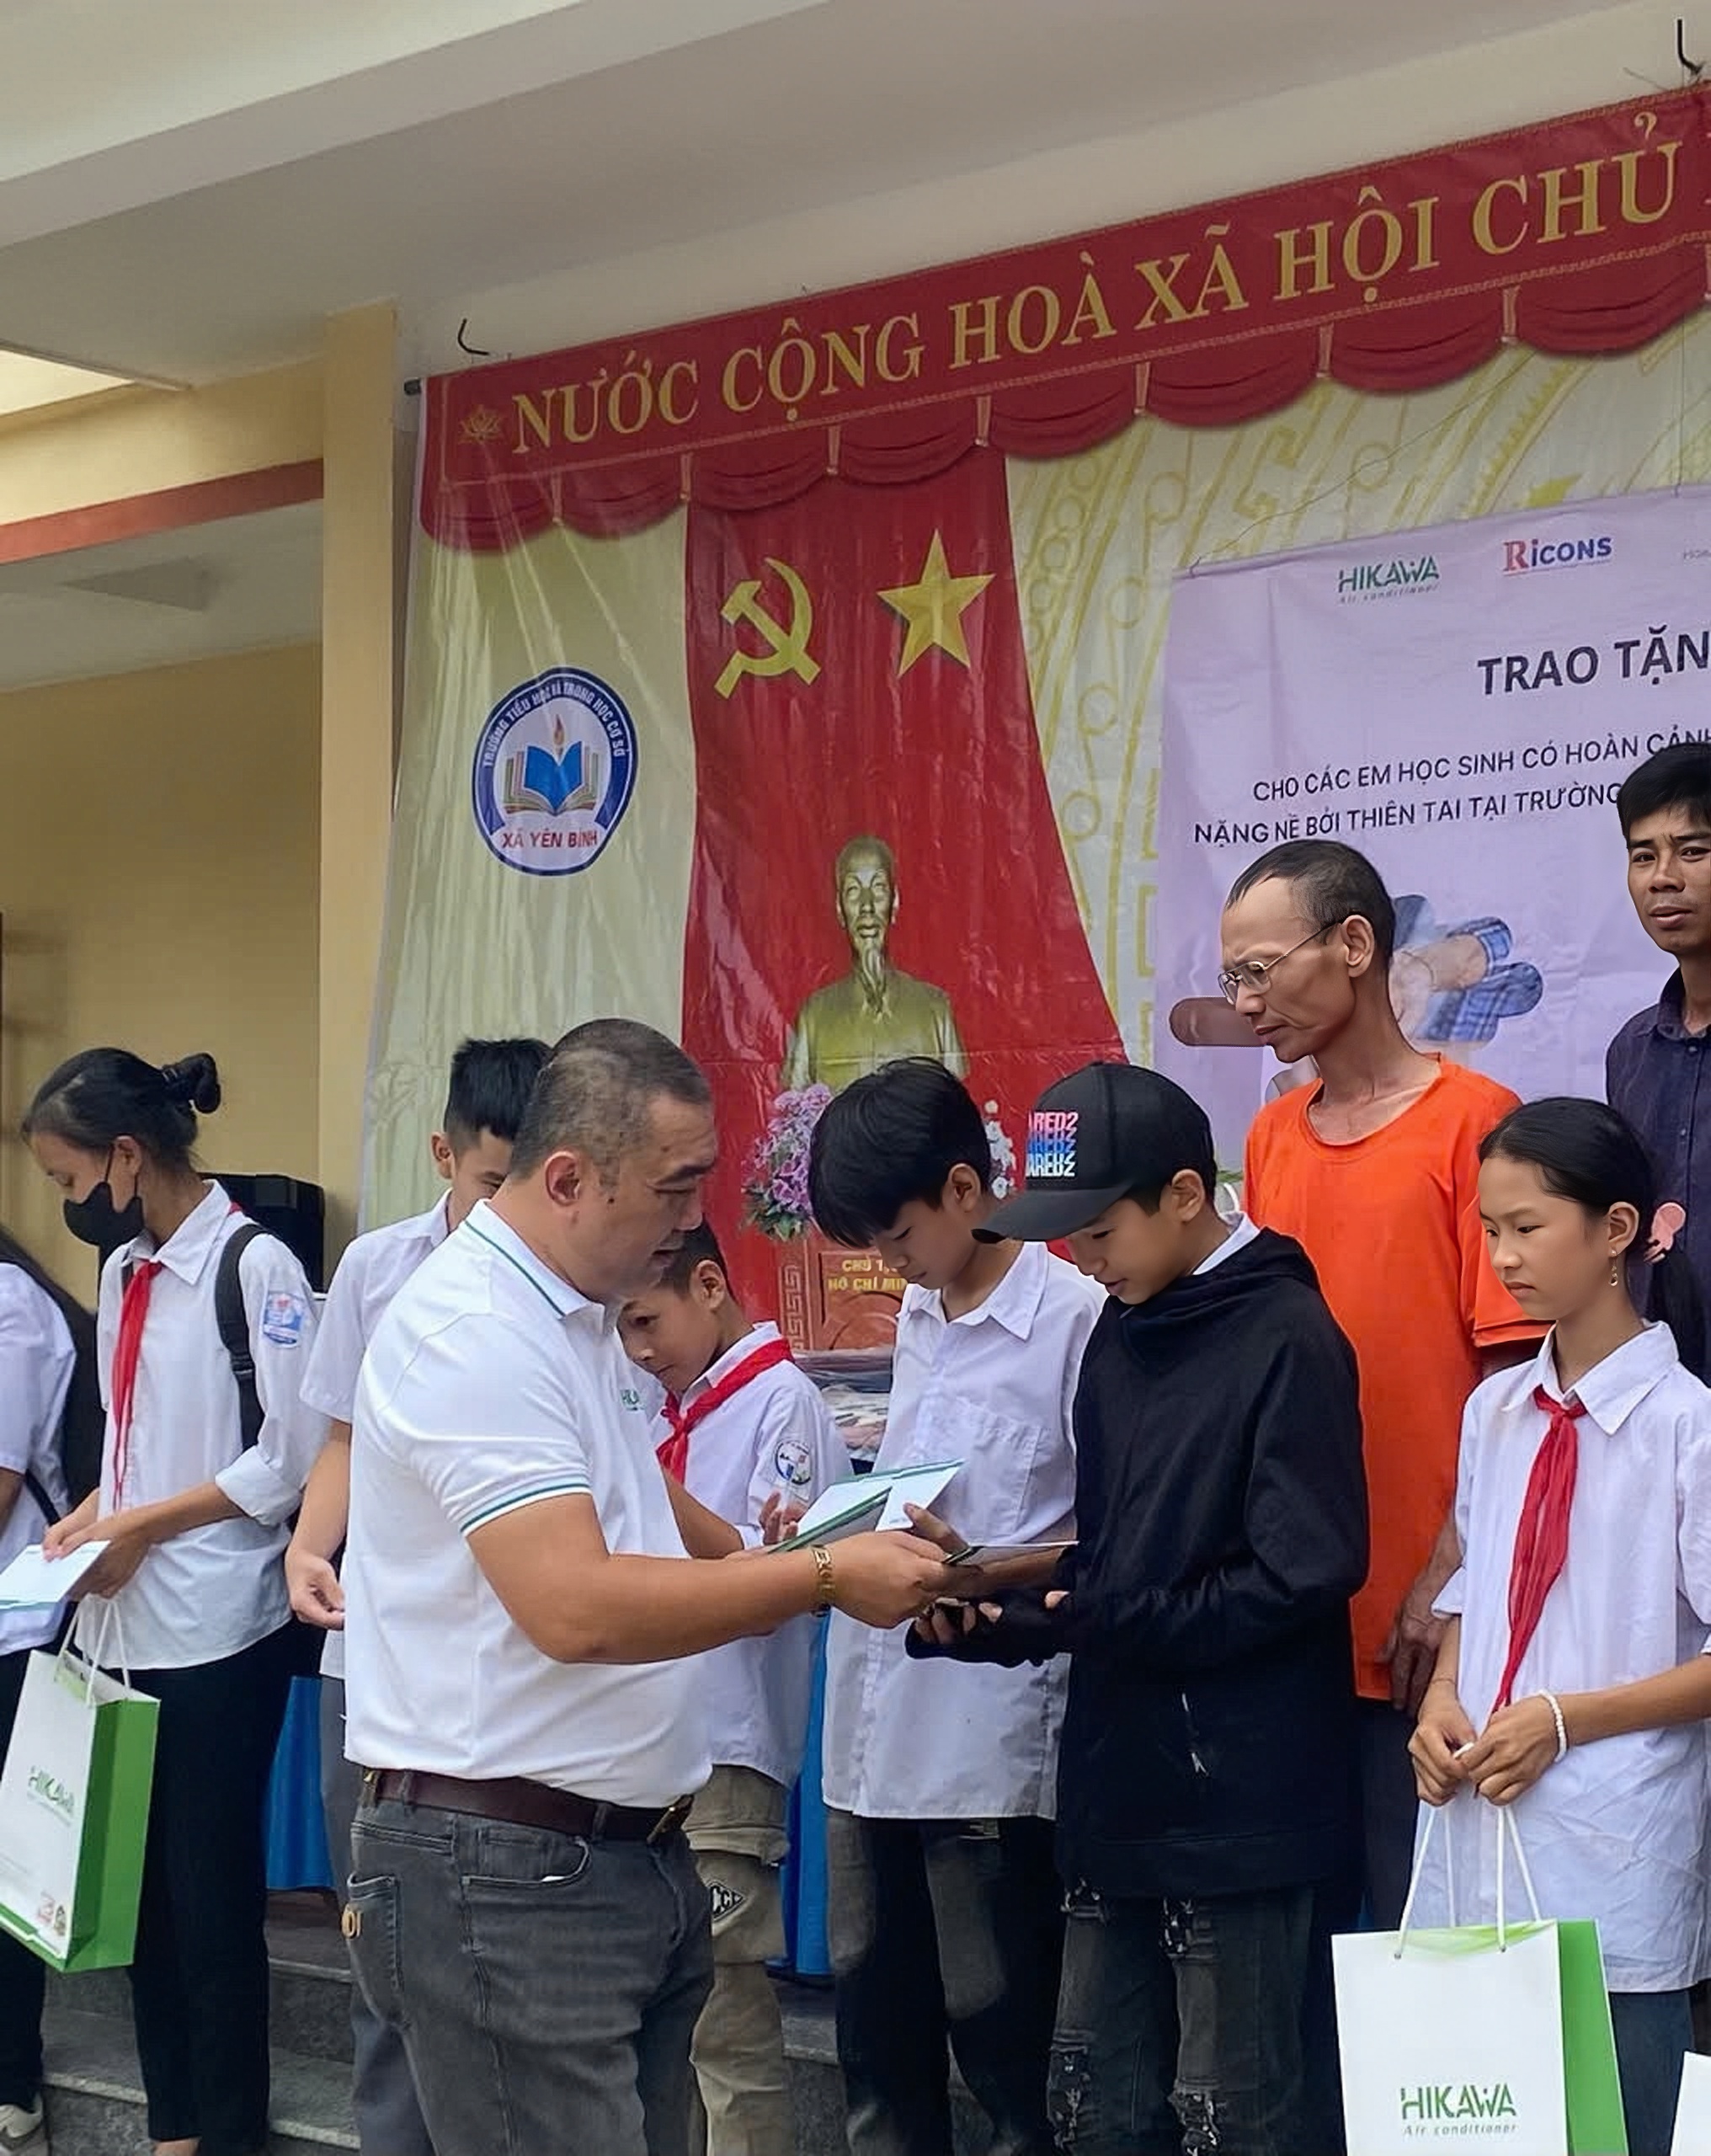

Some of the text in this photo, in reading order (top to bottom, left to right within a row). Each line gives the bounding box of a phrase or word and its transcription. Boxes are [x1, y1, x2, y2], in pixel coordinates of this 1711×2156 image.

[512, 350, 698, 455] NƯỚC
[722, 312, 925, 422] CỘNG
[948, 251, 1117, 369] HOÀ
[1134, 221, 1250, 332] XÃ
[1273, 185, 1440, 303] HỘI
[1472, 111, 1682, 255] CHỦ
[1339, 556, 1439, 593] HIKAWA
[1477, 646, 1599, 695] TRAO
[1253, 776, 1299, 801] CHO
[1304, 764, 1351, 794] CÁC
[1358, 764, 1391, 787] EM
[1399, 758, 1450, 786] HỌC
[1458, 750, 1514, 776] SINH
[1522, 739, 1558, 769] CÓ
[1565, 733, 1639, 765] HOÀN
[530, 827, 563, 848] YÊN
[1195, 819, 1269, 847] NẶNG
[1306, 806, 1341, 836] BỞI
[1347, 800, 1415, 831] THIÊN
[1422, 799, 1461, 823] TAI
[1468, 794, 1506, 821] TẠI
[1400, 2083, 1516, 2120] HIKAWA
